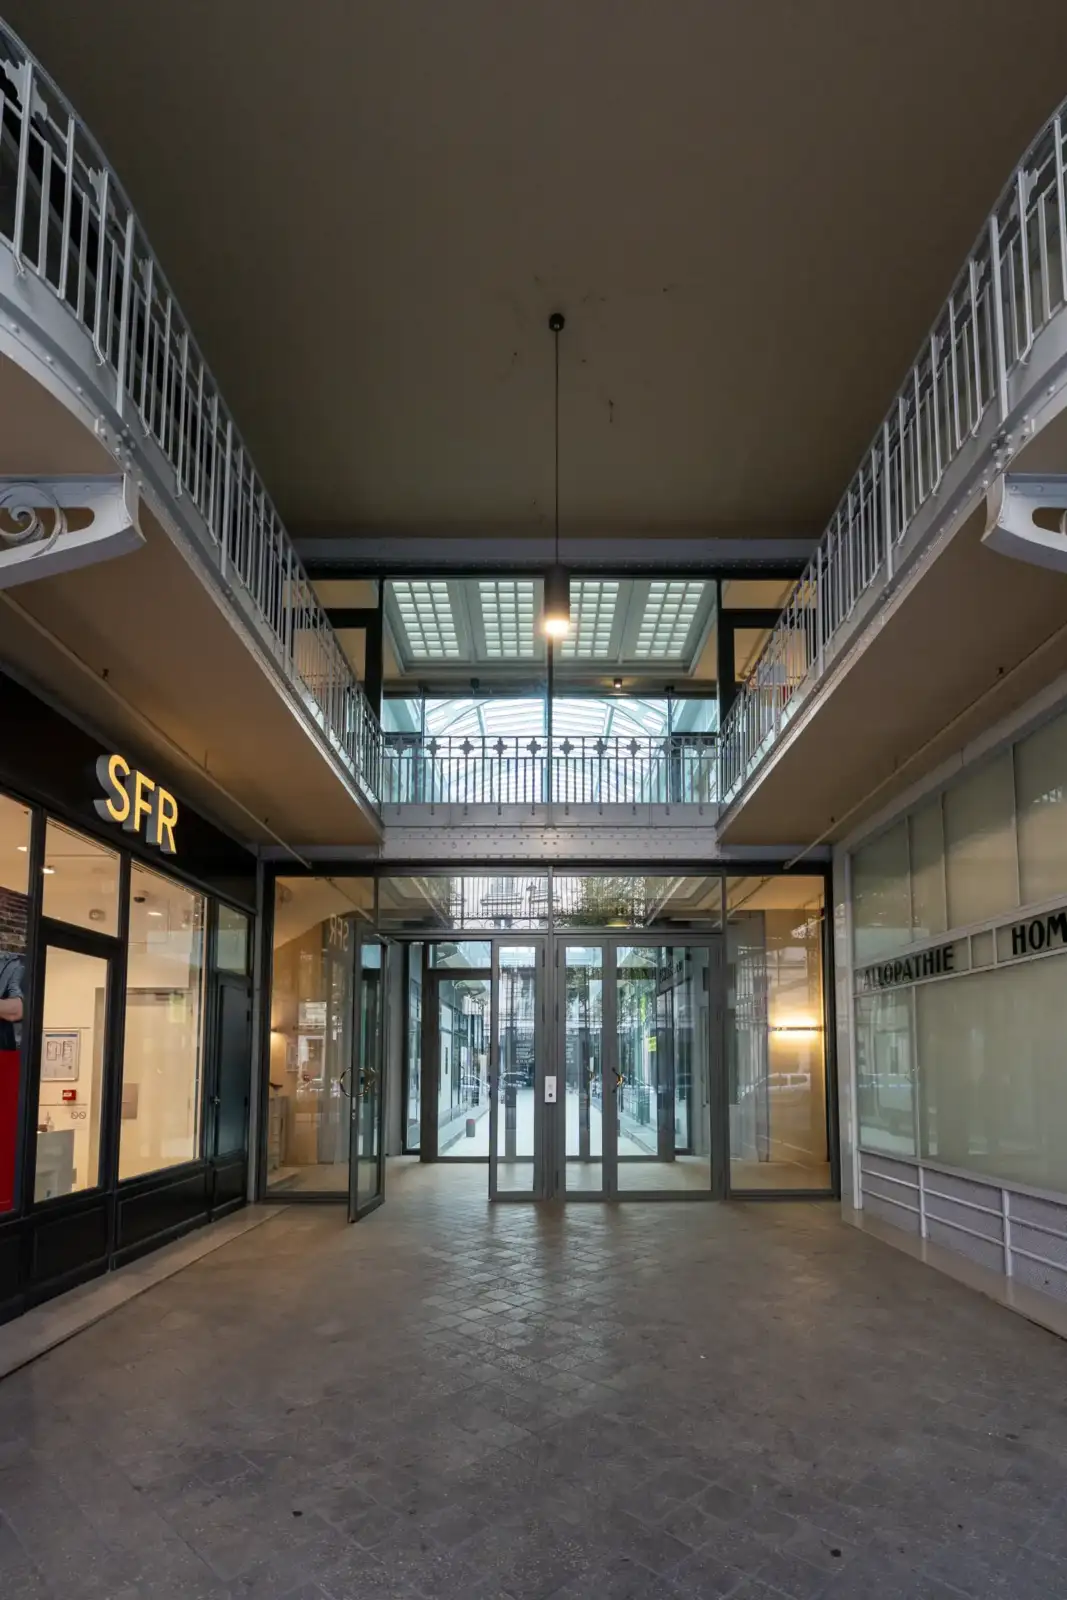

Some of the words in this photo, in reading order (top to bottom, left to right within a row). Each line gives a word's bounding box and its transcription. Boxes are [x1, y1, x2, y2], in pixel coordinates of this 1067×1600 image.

[94, 754, 179, 855] SFR
[863, 945, 955, 991] ALLOPATHIE
[1011, 912, 1067, 956] HOM
